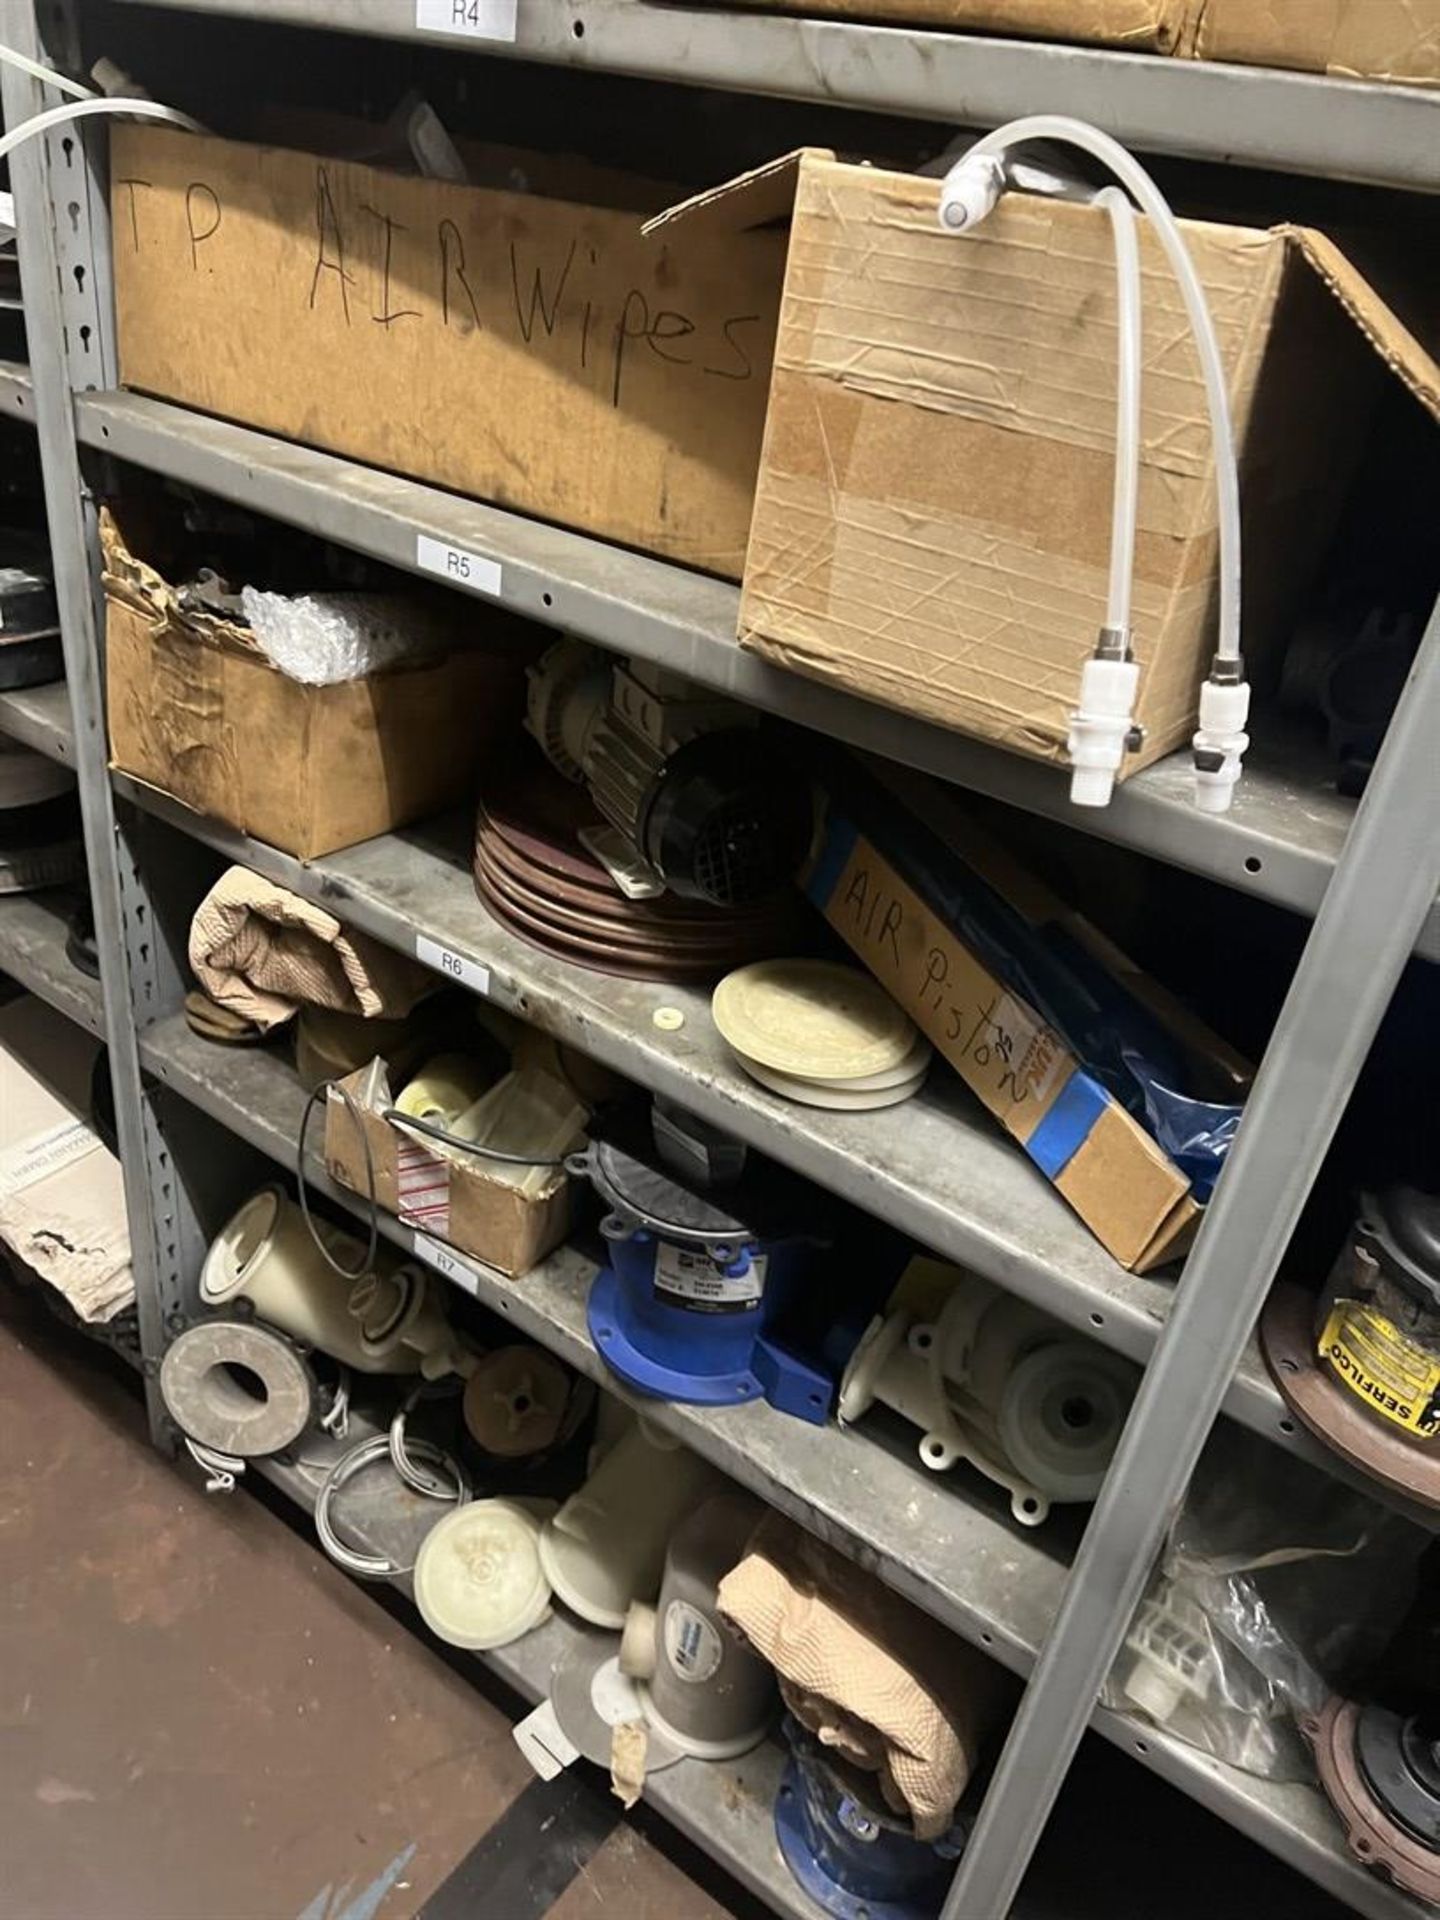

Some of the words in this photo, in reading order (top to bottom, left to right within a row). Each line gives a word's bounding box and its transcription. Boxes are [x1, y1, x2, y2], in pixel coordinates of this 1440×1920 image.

[452, 0, 479, 26] R4
[309, 165, 482, 330] AIR
[510, 239, 761, 409] Wipes
[447, 551, 471, 578] R5
[845, 869, 904, 969] AIR
[442, 952, 463, 975] R6
[437, 1252, 456, 1273] R7
[1330, 1344, 1413, 1420] SERFILCO
